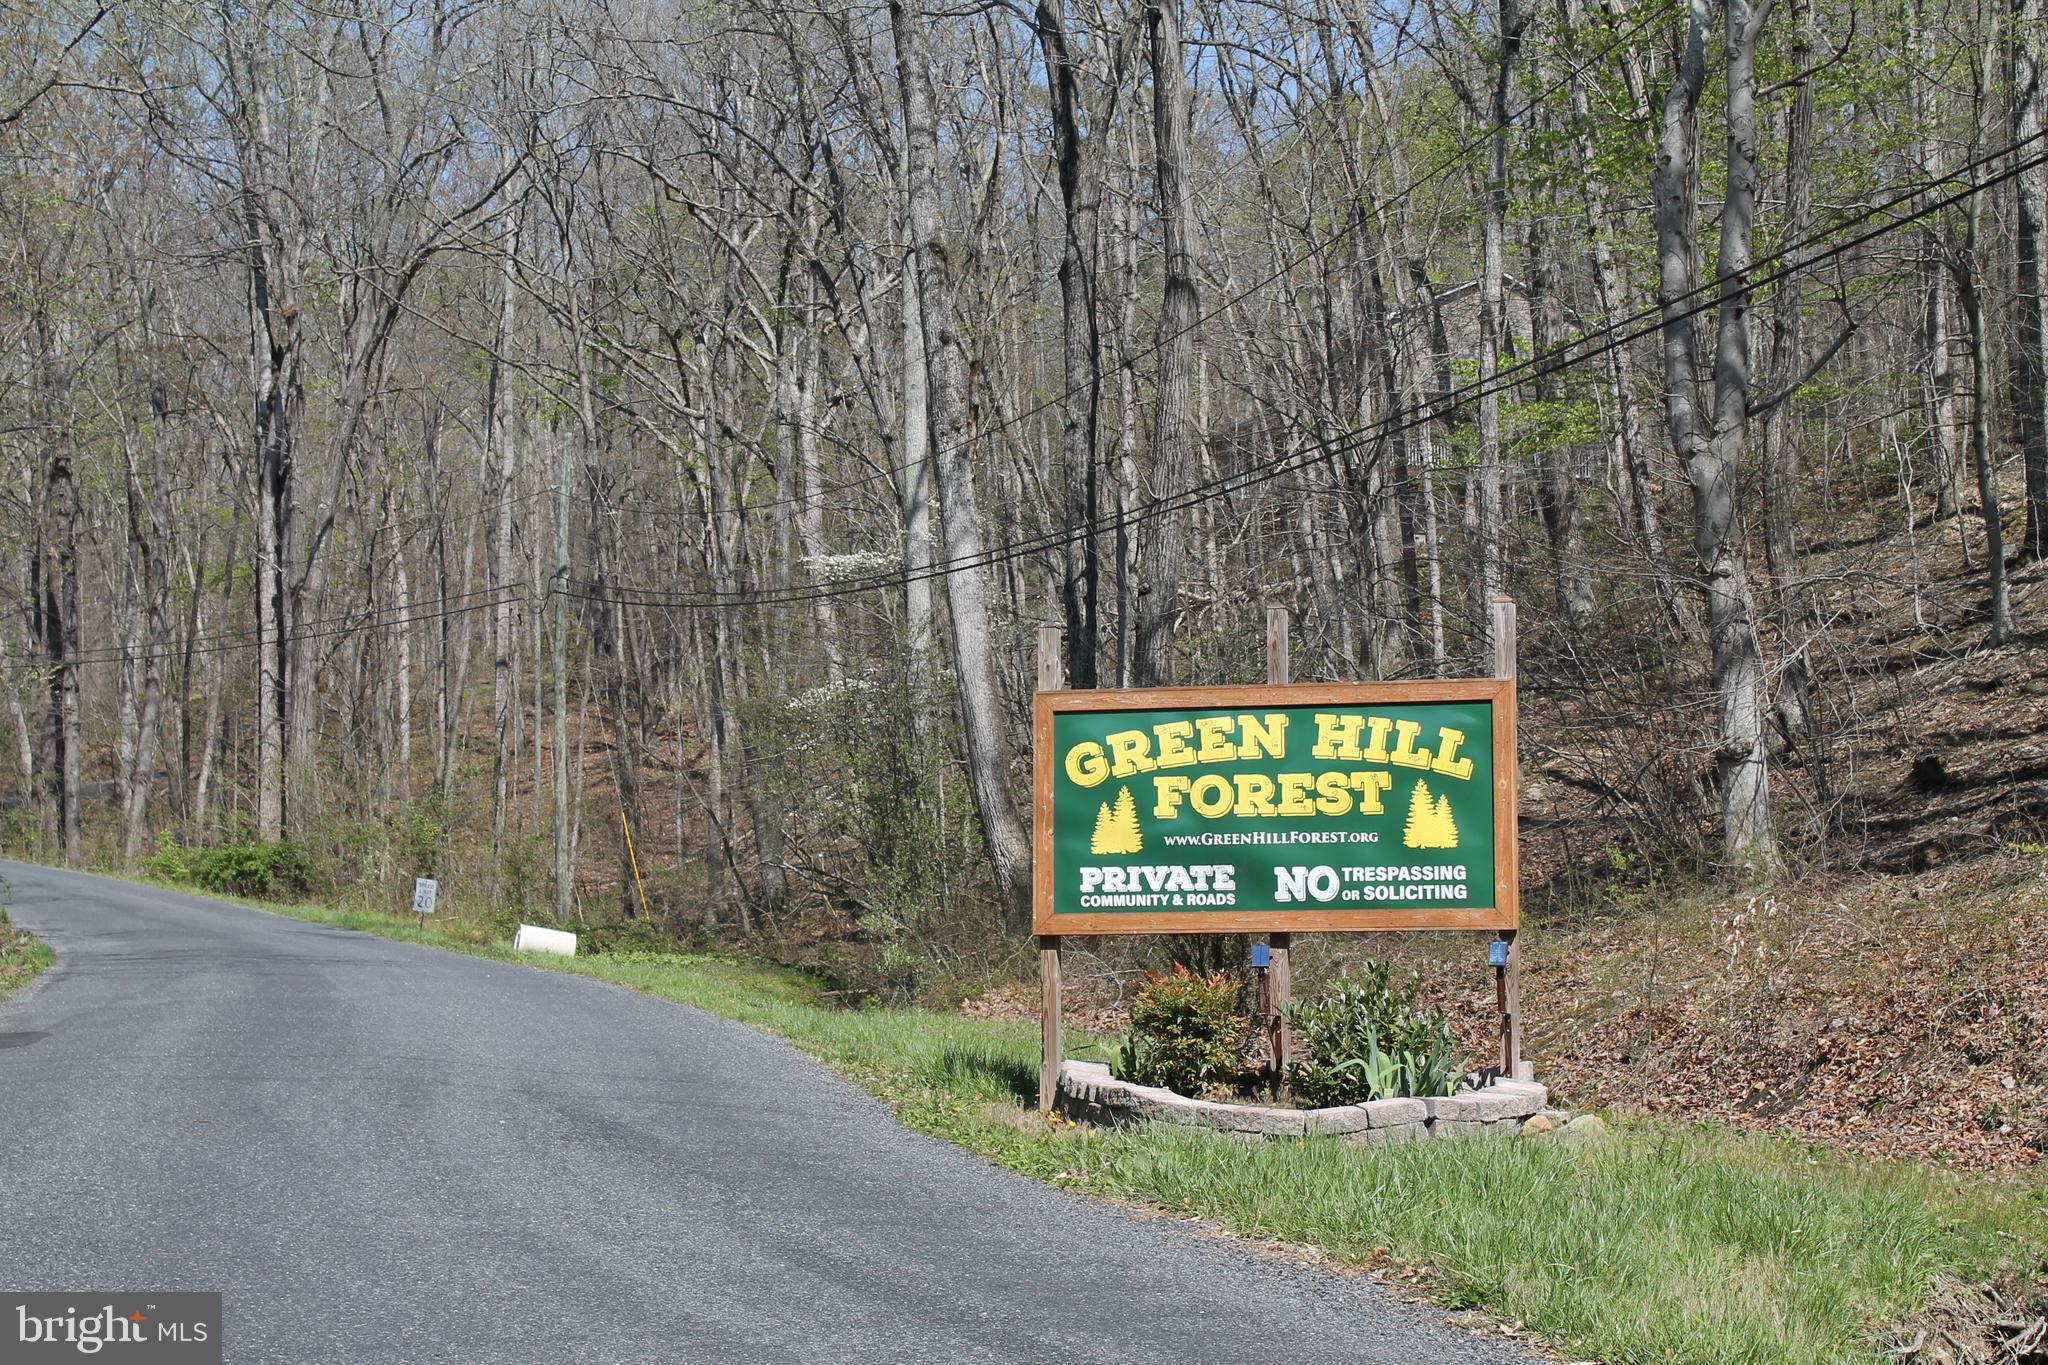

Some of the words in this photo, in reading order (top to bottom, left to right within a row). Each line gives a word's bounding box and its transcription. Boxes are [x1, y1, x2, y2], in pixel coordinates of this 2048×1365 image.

[1065, 713, 1289, 788] GREEN
[1312, 713, 1474, 781] HILL
[1153, 771, 1392, 819] FOREST
[1080, 865, 1236, 892] PRIVATE
[1274, 865, 1340, 902] NO
[1342, 865, 1467, 881] TRESPASSING
[417, 895, 433, 909] 20
[1080, 894, 1170, 907] COMMUNITY
[1172, 894, 1184, 906] &
[1187, 893, 1236, 906] ROADS
[1342, 890, 1360, 901] OR
[1363, 884, 1467, 901] SOLICITING
